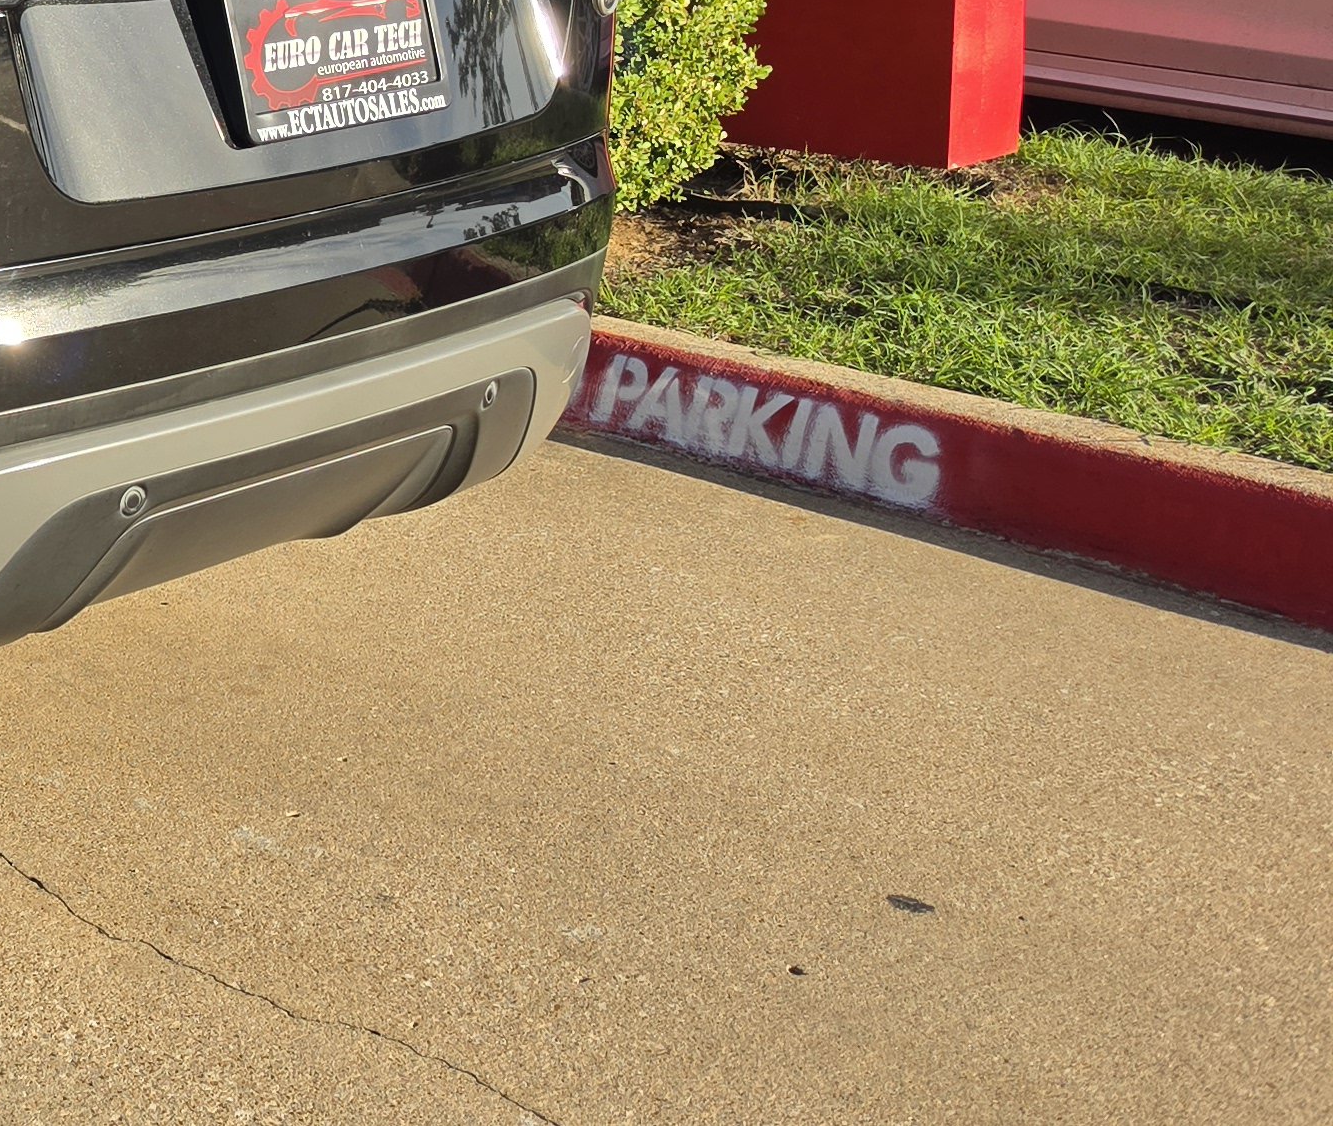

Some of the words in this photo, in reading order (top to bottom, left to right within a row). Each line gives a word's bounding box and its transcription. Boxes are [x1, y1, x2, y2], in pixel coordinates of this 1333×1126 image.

[263, 35, 321, 73] EURO
[328, 28, 369, 61] CAR
[374, 18, 422, 53] TECH
[318, 58, 369, 76] european
[370, 47, 426, 68] automotive
[321, 70, 429, 102] 817-404-4033
[257, 88, 446, 142] www.ECTAUTOSALES.com
[589, 354, 941, 508] PARKING
